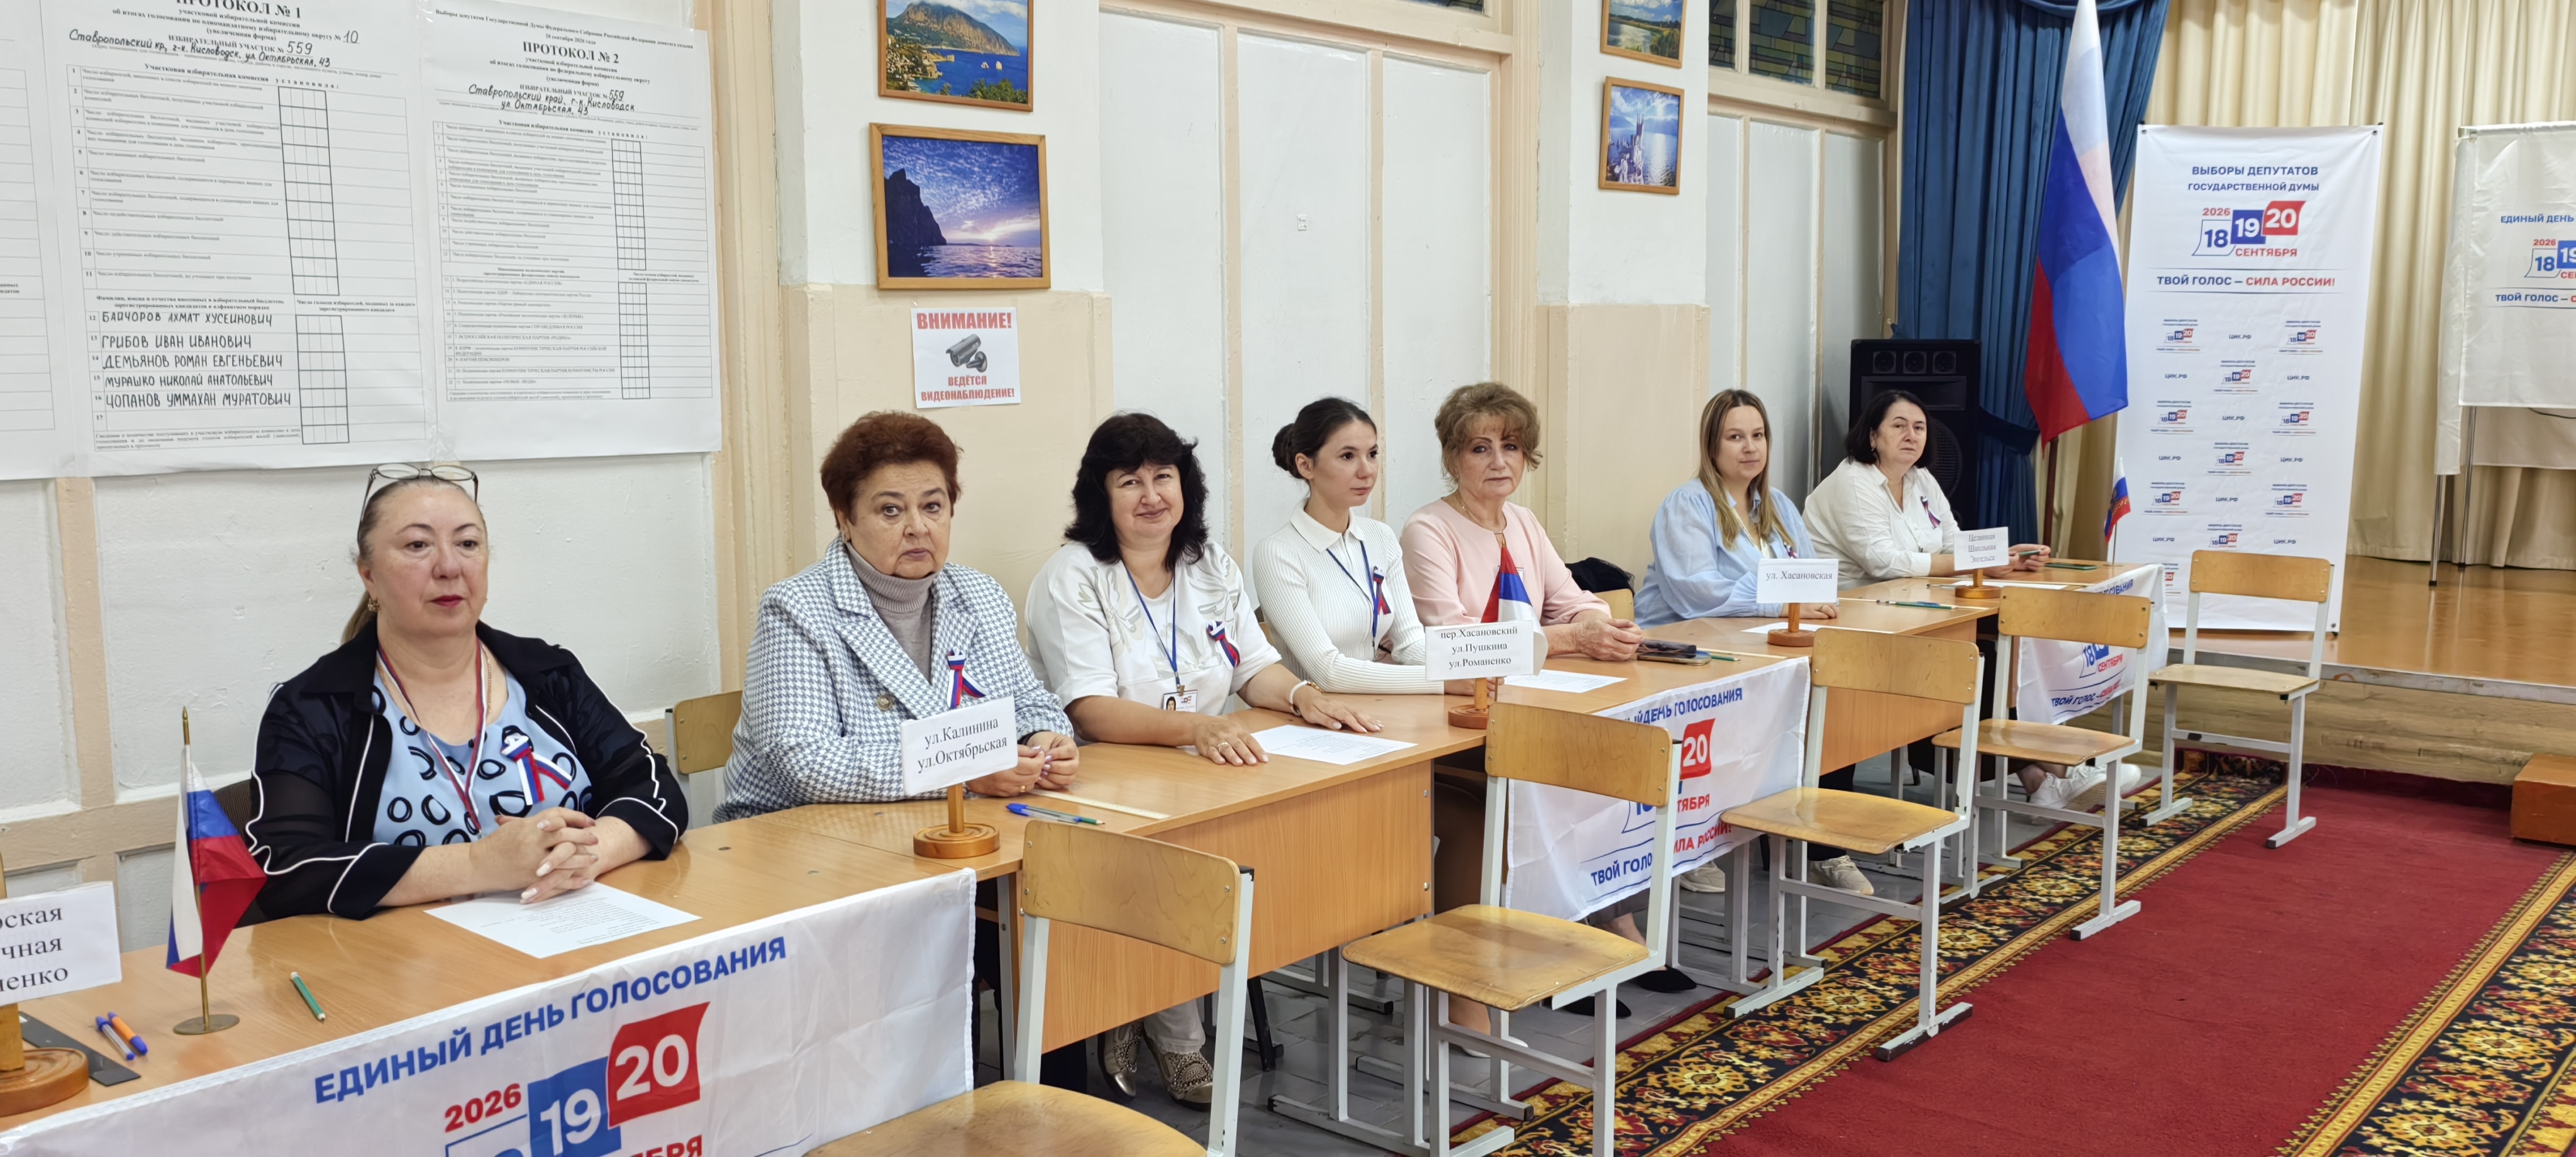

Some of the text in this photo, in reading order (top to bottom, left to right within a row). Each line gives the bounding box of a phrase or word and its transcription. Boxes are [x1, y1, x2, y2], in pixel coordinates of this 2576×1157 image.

[177, 0, 301, 18] ОТОКОЛ № 1
[147, 13, 191, 23] голосования
[202, 19, 257, 31] одномандатному
[258, 26, 310, 38] избирательному
[179, 8, 301, 28] участковой избирательной комиссии
[169, 35, 237, 48] ИЗБИРАТЕЛЬНЫЙ
[239, 43, 275, 52] УЧАСТОК
[343, 30, 358, 43] 10
[69, 28, 152, 48] Ставропольский
[319, 57, 331, 67] 43
[286, 41, 313, 55] 559
[523, 41, 619, 64] ПРОТОКОЛ № 2
[469, 84, 541, 101] Ставропольский
[609, 89, 625, 101] 559
[2192, 166, 2319, 177] ВЫБОРЫ ДЕПУТАТОВ
[2188, 182, 2319, 192] ГОСУДАРСТВЕННОЙ ДУМЫ
[2202, 208, 2231, 216] 2026
[2501, 214, 2574, 224] ЕДИНЫЙ ДЕНЬ
[2204, 208, 2297, 248] 18 19 20
[2235, 248, 2298, 257] СЕНТЯБРЯ
[2535, 256, 2555, 272] 18
[2157, 274, 2189, 285] ТВОЙ
[2192, 277, 2232, 285] ГОЛОС
[2246, 277, 2279, 286] СИЛА
[2282, 277, 2336, 287] РОССИИ!
[2496, 292, 2522, 302] ТВОЙ
[2524, 294, 2558, 302] ГОЛОС
[168, 312, 200, 323] АХМАТ
[916, 312, 1012, 329] ВНИМАНИЕ!
[102, 334, 252, 348] ГРИБОВ ИВАН ИВАНОВИЧ
[103, 354, 283, 370] ДЕМЬЯНОВ РОМАН ЕВГЕНЬЕВИЧ
[105, 373, 273, 388] МУРАШКО НИКОЛАЙ АНАТОЛЬЕВИЧ
[948, 375, 987, 387] ВЕДЁТСЯ
[106, 392, 292, 408] ЧОПАНОВ УММАХАН МУРАТОВИЧ
[921, 388, 1014, 402] ВИДЕОНАБЛЮДЕНИЕ!
[1765, 570, 1833, 582] ул. Хасановская
[1441, 626, 1518, 640] пер.Хасановский
[1452, 643, 1507, 655] ул.Пушкина
[2083, 645, 2096, 667] 18
[1449, 656, 1511, 670] ул.Романенко
[2098, 654, 2123, 672] СЕНТЯБРЯ
[1643, 704, 1672, 724] ДЕНЬ
[1674, 687, 1743, 717] ГОЛОСОВАНИЯ
[2051, 695, 2074, 707] ТВОЙ
[2072, 693, 2096, 705] ГОЛОС
[924, 718, 998, 750] ул.Калинина
[918, 737, 1007, 773] ул.Октябрьская
[1682, 733, 1708, 768] 20
[1677, 793, 1710, 813] ТЯБРЯ
[1591, 860, 1620, 887] ТВОЙ
[1623, 852, 1652, 875] ГОЛО
[1674, 837, 1695, 854] ИЛА
[314, 936, 787, 1104] ЕДИНЫЙ ДЕНЬ ГОЛОСОВАНИЯ
[540, 1039, 690, 1157] 19 20
[445, 1083, 521, 1132] 2026
